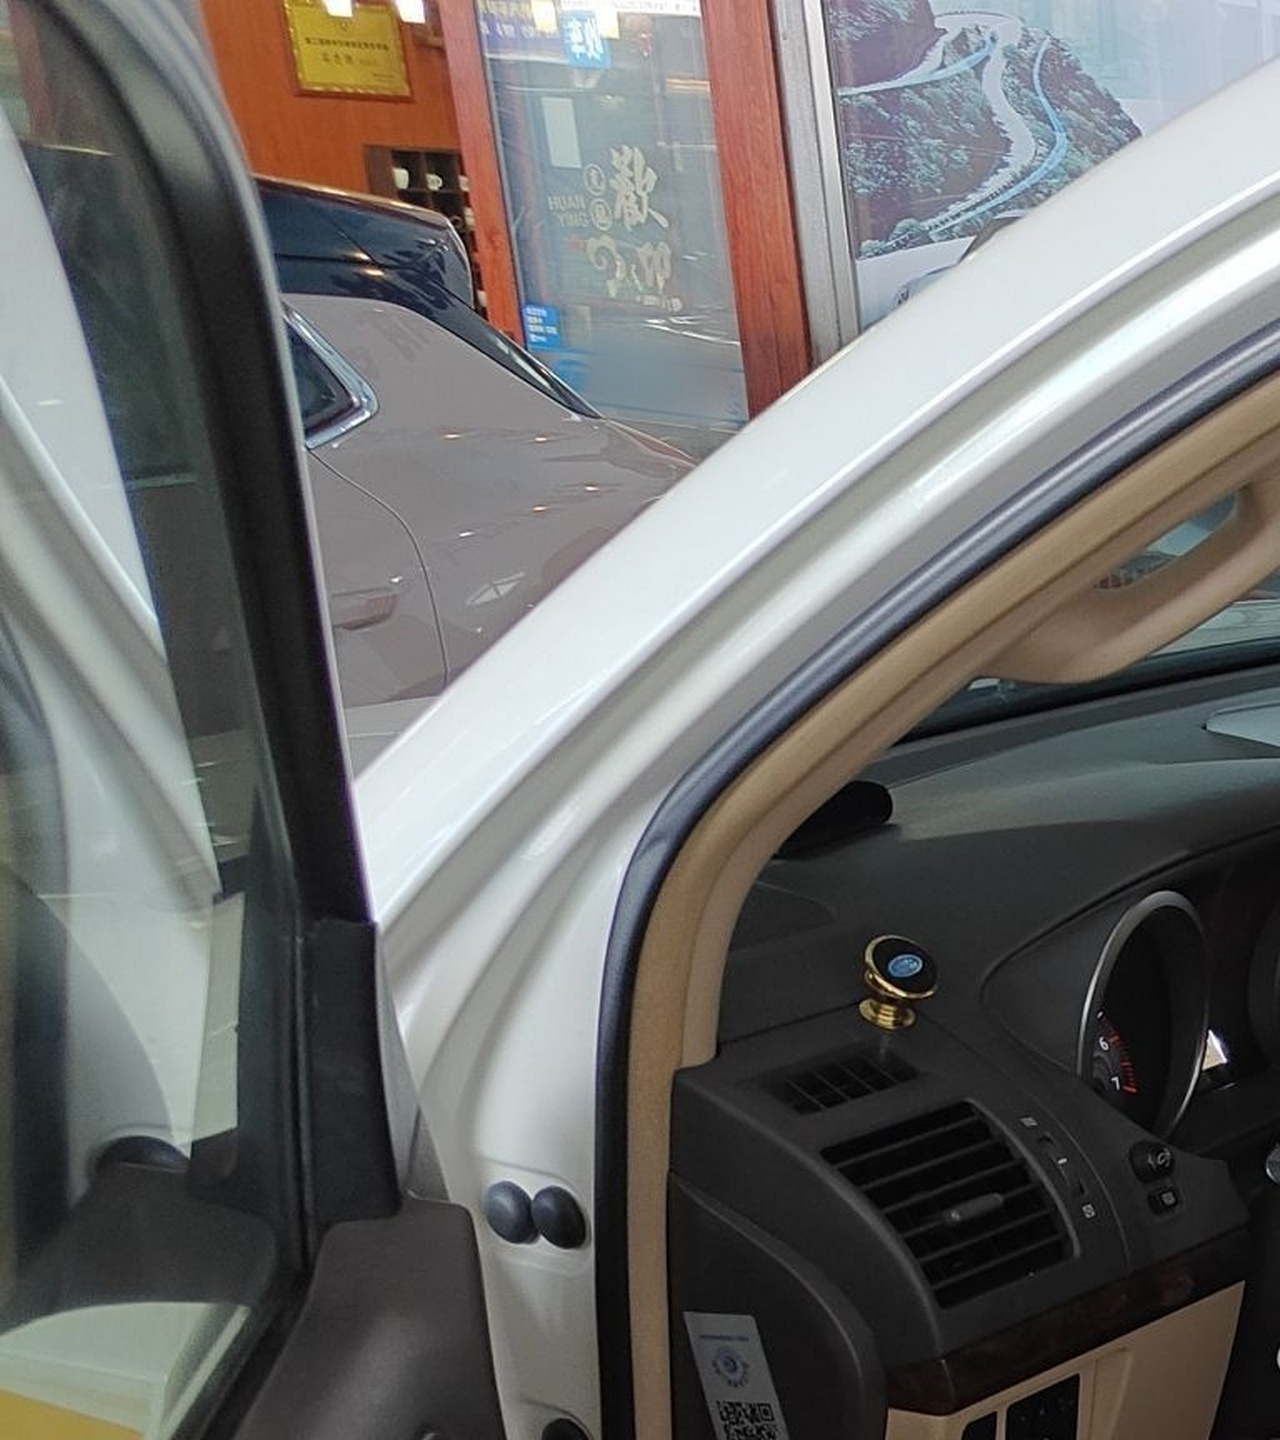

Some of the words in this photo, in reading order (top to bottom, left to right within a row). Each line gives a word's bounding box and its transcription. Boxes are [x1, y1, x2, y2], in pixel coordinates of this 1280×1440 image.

[548, 195, 586, 211] HUAN
[1099, 1036, 1110, 1051] 6
[1110, 1076, 1121, 1091] 7
